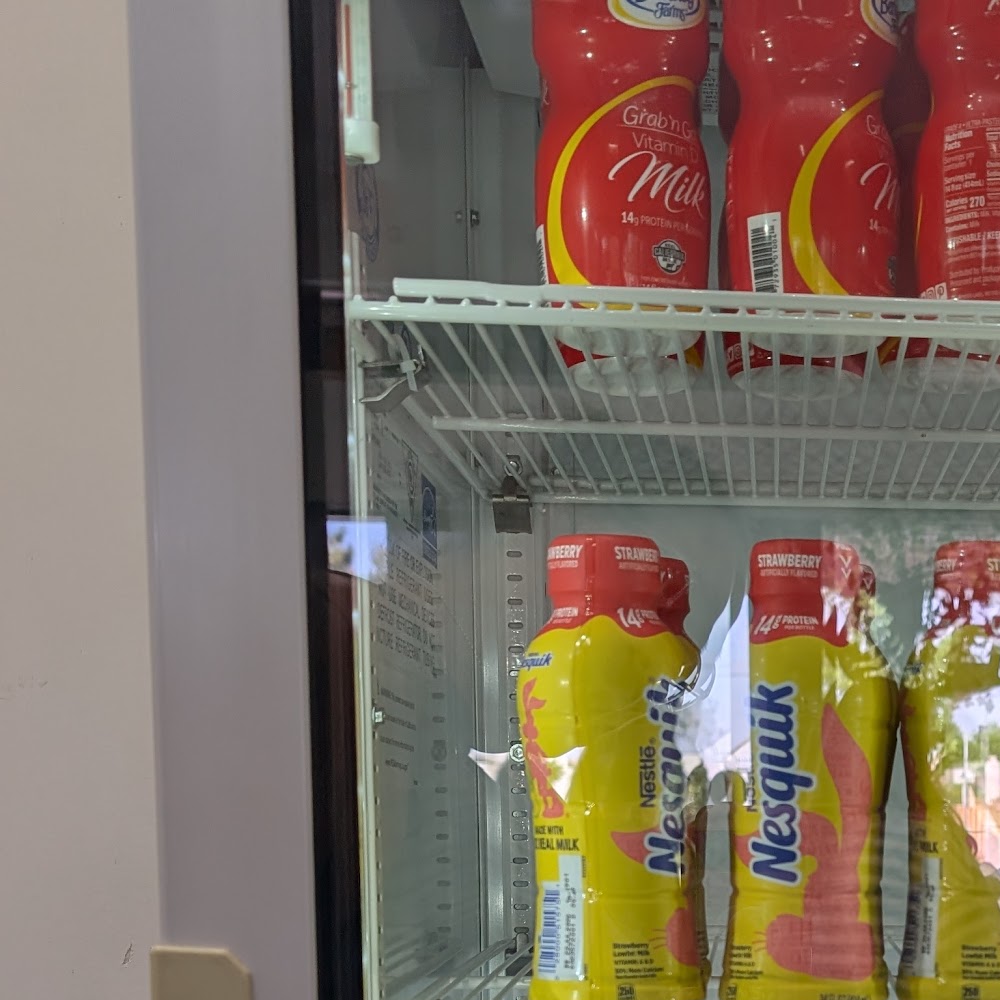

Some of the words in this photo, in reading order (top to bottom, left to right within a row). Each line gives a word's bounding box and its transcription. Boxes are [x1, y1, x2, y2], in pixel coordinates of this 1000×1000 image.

[632, 132, 688, 156] Vitamin
[608, 150, 706, 220] Milk
[969, 195, 986, 208] 270
[621, 211, 639, 226] 14g
[641, 215, 672, 229] PROTEIN
[757, 553, 822, 569] STRAWBERRY
[753, 615, 783, 636] 14g
[782, 615, 819, 625] PROTEIN
[639, 746, 656, 808] Nestlé
[747, 684, 813, 884] Nesquik
[557, 838, 581, 852] MILK
[961, 944, 997, 952] Strawberry
